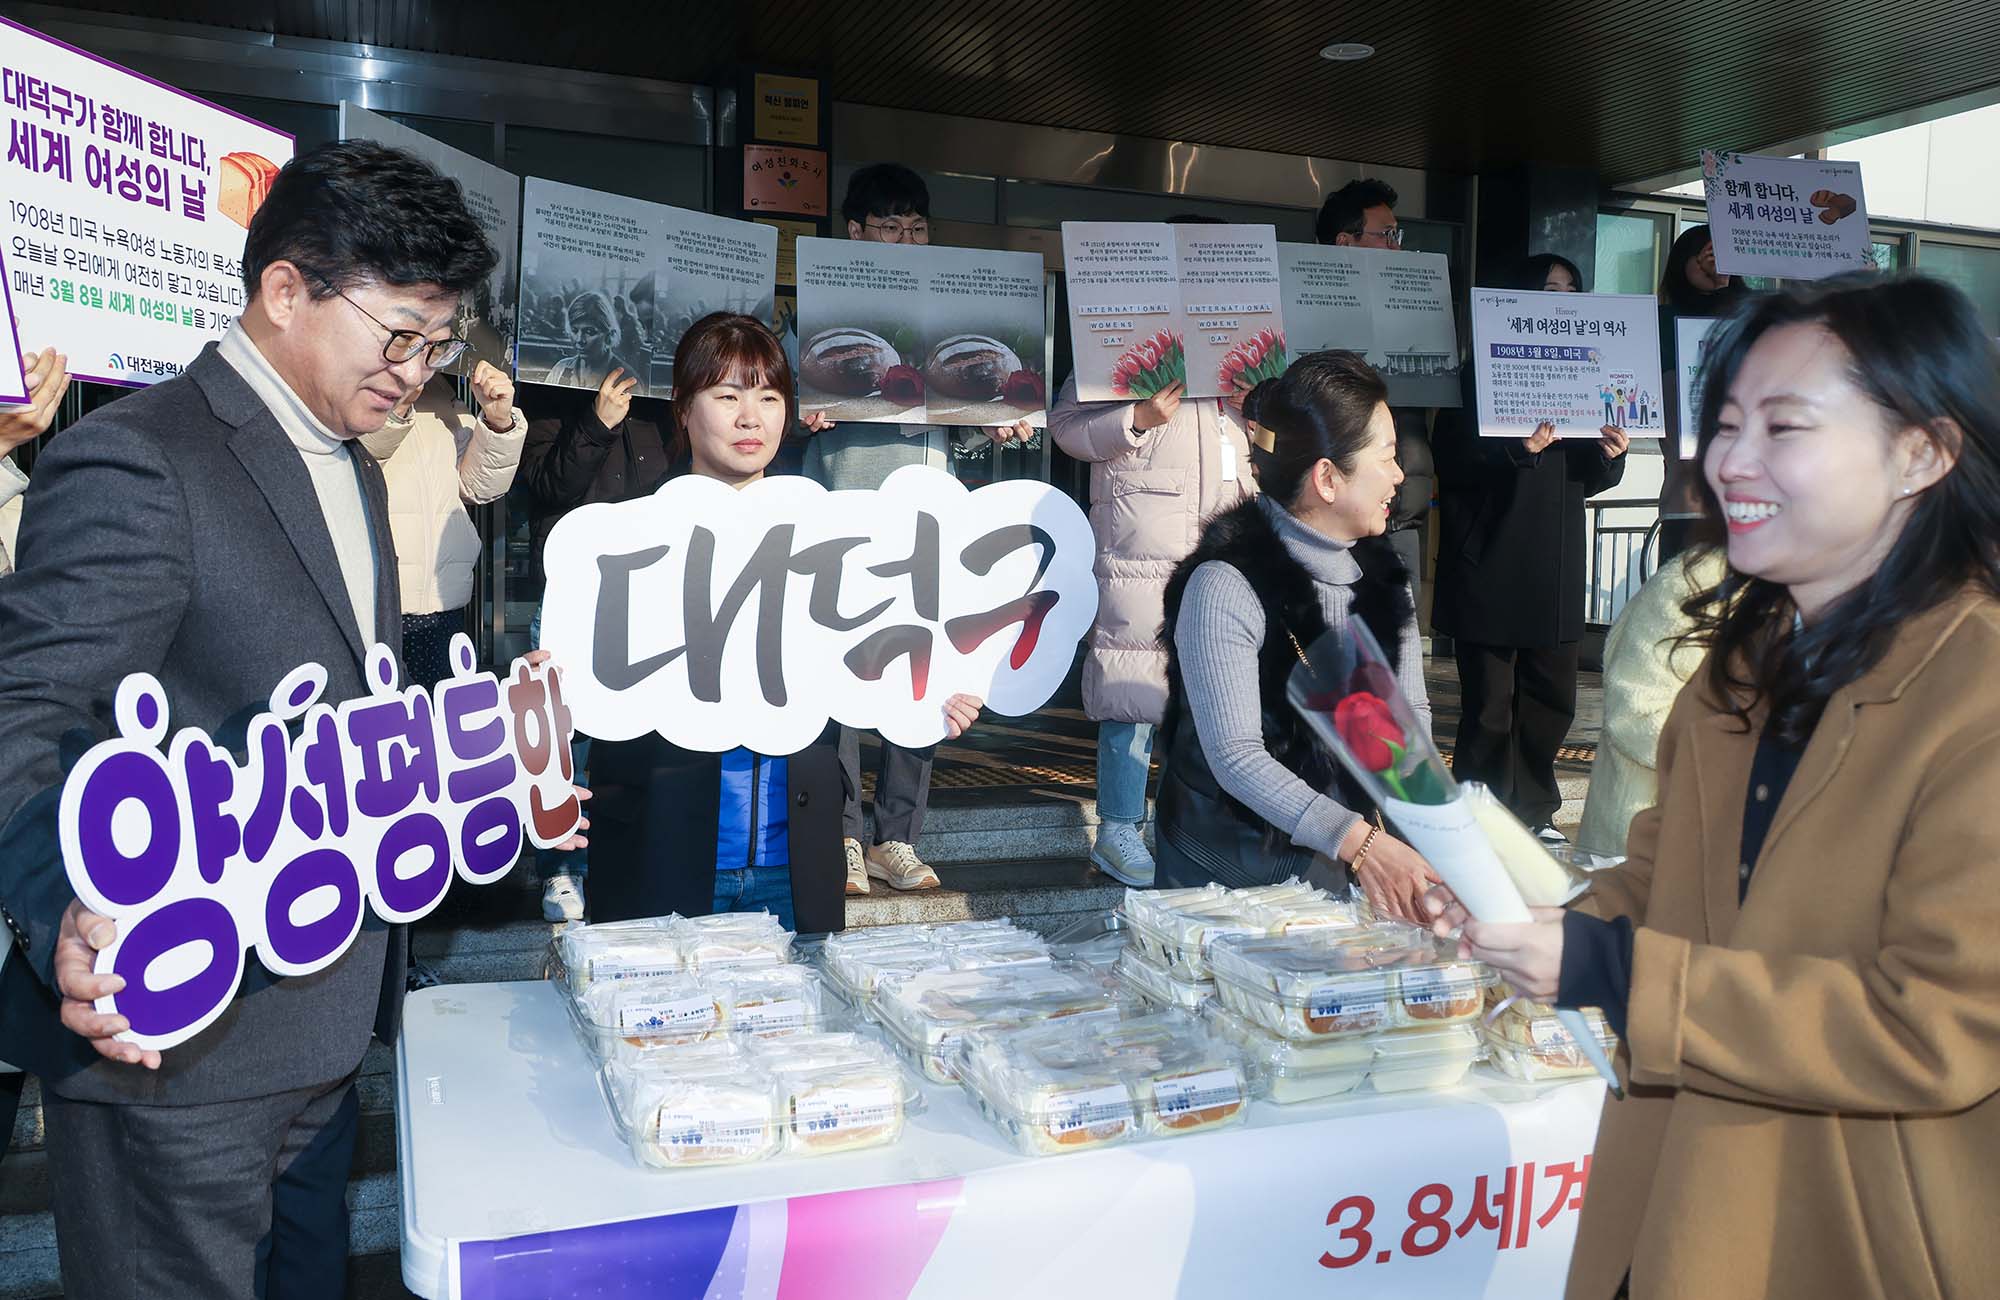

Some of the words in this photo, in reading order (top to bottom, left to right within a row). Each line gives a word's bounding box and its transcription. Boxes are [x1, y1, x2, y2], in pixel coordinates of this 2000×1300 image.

[2, 66, 97, 131] 대덕구가
[101, 104, 144, 152] 함께
[147, 121, 211, 177] 합니다,
[8, 119, 72, 184] 세계
[84, 144, 172, 213] 여성의
[180, 176, 207, 223] 날
[752, 156, 822, 178] 여성친화도시
[1724, 179, 1751, 199] 함께
[1754, 182, 1799, 202] 합니다,
[1727, 202, 1754, 221] 세계
[1757, 205, 1797, 223] 여성의
[1800, 208, 1814, 225] 날
[9, 200, 64, 233] 1908년
[69, 216, 98, 244] 미국
[102, 224, 156, 258] 뉴욕여성
[160, 243, 210, 271] 노동자의
[12, 237, 59, 267] 오늘날
[63, 247, 121, 280] 우리에게
[124, 262, 164, 291] 여전히
[167, 272, 193, 297] 닿고
[195, 279, 246, 309] 있습니다.
[13, 270, 45, 298] 매년
[49, 278, 75, 304] 3월
[79, 284, 104, 309] 8일
[108, 290, 136, 315] 세계
[139, 296, 178, 324] 여성의
[181, 305, 207, 329] 날을
[1081, 305, 1168, 313] INTERNATIONAL
[1091, 321, 1132, 329] WOMENS
[1199, 320, 1238, 328] WOMENS
[1536, 319, 1571, 336] 여성의
[1603, 321, 1627, 337] 역사
[1496, 345, 1525, 358] 1908년
[1528, 347, 1542, 359] 3월
[1544, 347, 1562, 360] 8일,
[1564, 348, 1582, 360] 미국
[593, 510, 1060, 708] 대덕구
[78, 640, 580, 1037] 양성평등한
